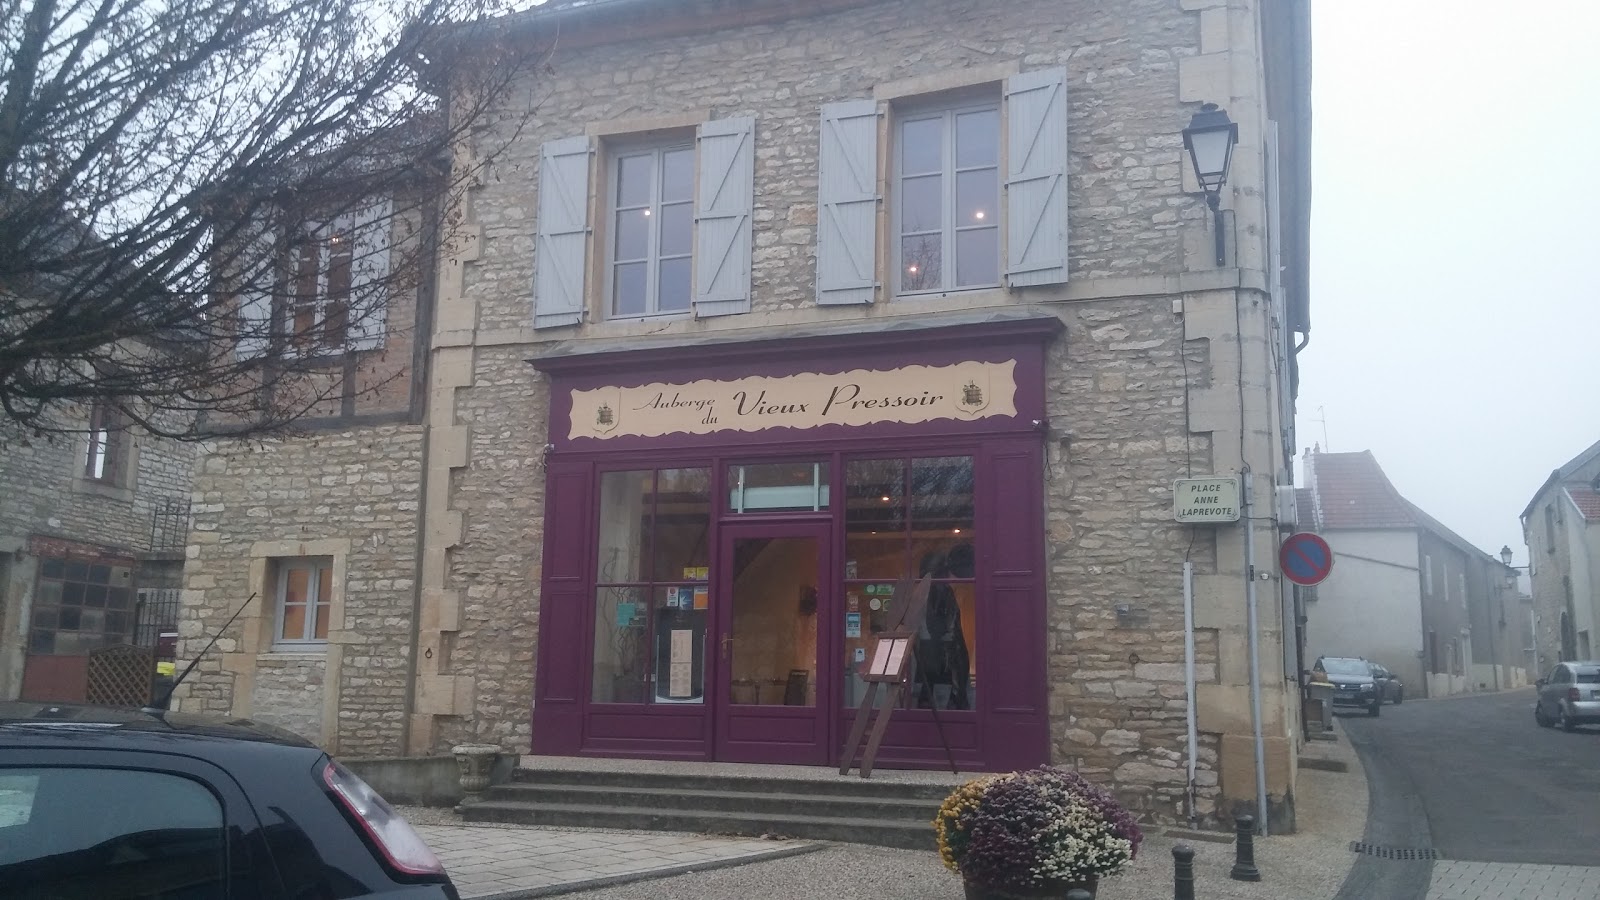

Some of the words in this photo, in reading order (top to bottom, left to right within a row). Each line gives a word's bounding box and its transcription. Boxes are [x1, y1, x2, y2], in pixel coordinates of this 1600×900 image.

[634, 391, 715, 411] Auberge
[733, 391, 811, 415] Vieux
[822, 384, 944, 416] Pressoir
[701, 406, 719, 425] du
[1191, 484, 1221, 492] PLACE
[1194, 496, 1219, 504] ANNE
[1182, 507, 1232, 516] LAPREVOTE
